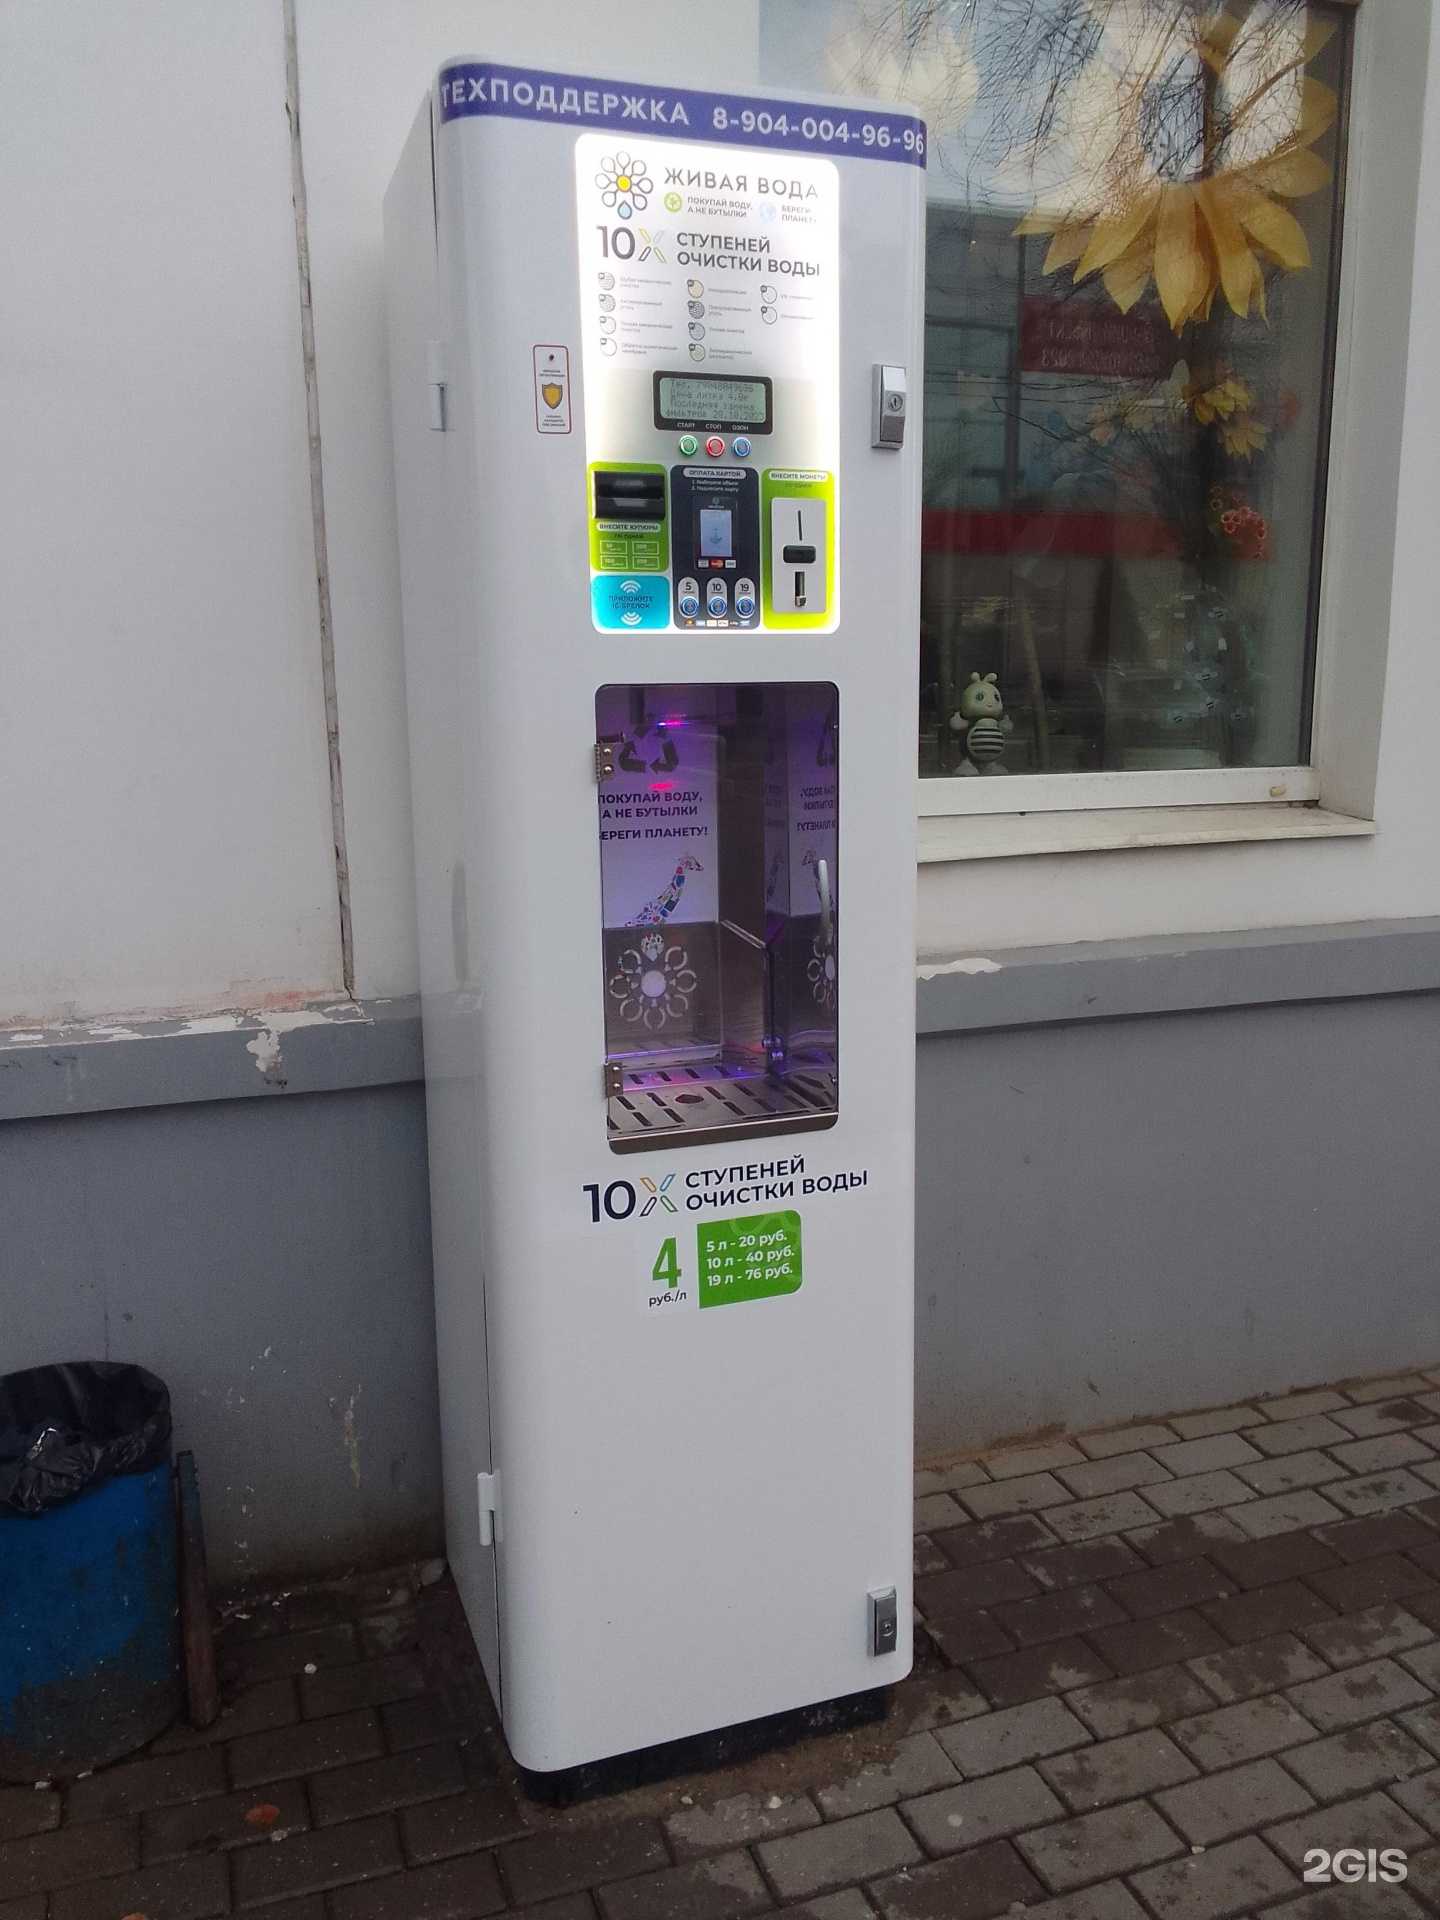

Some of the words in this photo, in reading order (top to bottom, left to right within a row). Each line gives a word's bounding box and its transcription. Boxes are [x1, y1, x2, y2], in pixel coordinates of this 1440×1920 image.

[441, 78, 689, 126] ТЕХПОДДЕРЖКА
[712, 106, 924, 155] 8-904-004-96-96
[664, 167, 748, 192] ЖИВАЯ
[757, 176, 818, 200] ВОДА
[687, 195, 727, 207] ПОКУПАЙ
[696, 207, 707, 215] НЕ
[708, 208, 747, 218] БУТЫЛКИ
[676, 230, 771, 254] СТУПЕНЕЙ
[677, 251, 763, 273] ОЧИСТКИ
[768, 258, 820, 277] ВОДЫ
[685, 582, 692, 590] 5
[712, 583, 722, 592] 10
[740, 583, 749, 592] 19
[599, 790, 661, 804] ПОКУПАЙ
[665, 791, 702, 802] ВОДУ,
[602, 809, 611, 819] А
[615, 808, 632, 818] НЕ
[636, 806, 697, 817] БУТЫЛКИ
[600, 829, 641, 840] ЕРЕГИ
[645, 827, 708, 838] ПЛАНЕТУ!
[685, 1154, 805, 1187] СТУПЕНЕЙ
[686, 1180, 794, 1211] ОЧИСТКИ
[802, 1170, 868, 1195] ВОДЫ
[706, 1241, 715, 1252] 5
[717, 1240, 727, 1250] л
[738, 1234, 756, 1248] 20
[759, 1229, 788, 1247] руб.
[652, 1237, 682, 1289] 4
[707, 1257, 721, 1270] 10
[724, 1256, 734, 1267] л
[746, 1251, 764, 1263] 40
[766, 1246, 795, 1262] руб.
[707, 1274, 721, 1287] 19
[724, 1273, 734, 1285] л
[745, 1268, 762, 1281] 76
[765, 1263, 793, 1280] руб.
[649, 1290, 687, 1307] руб./л
